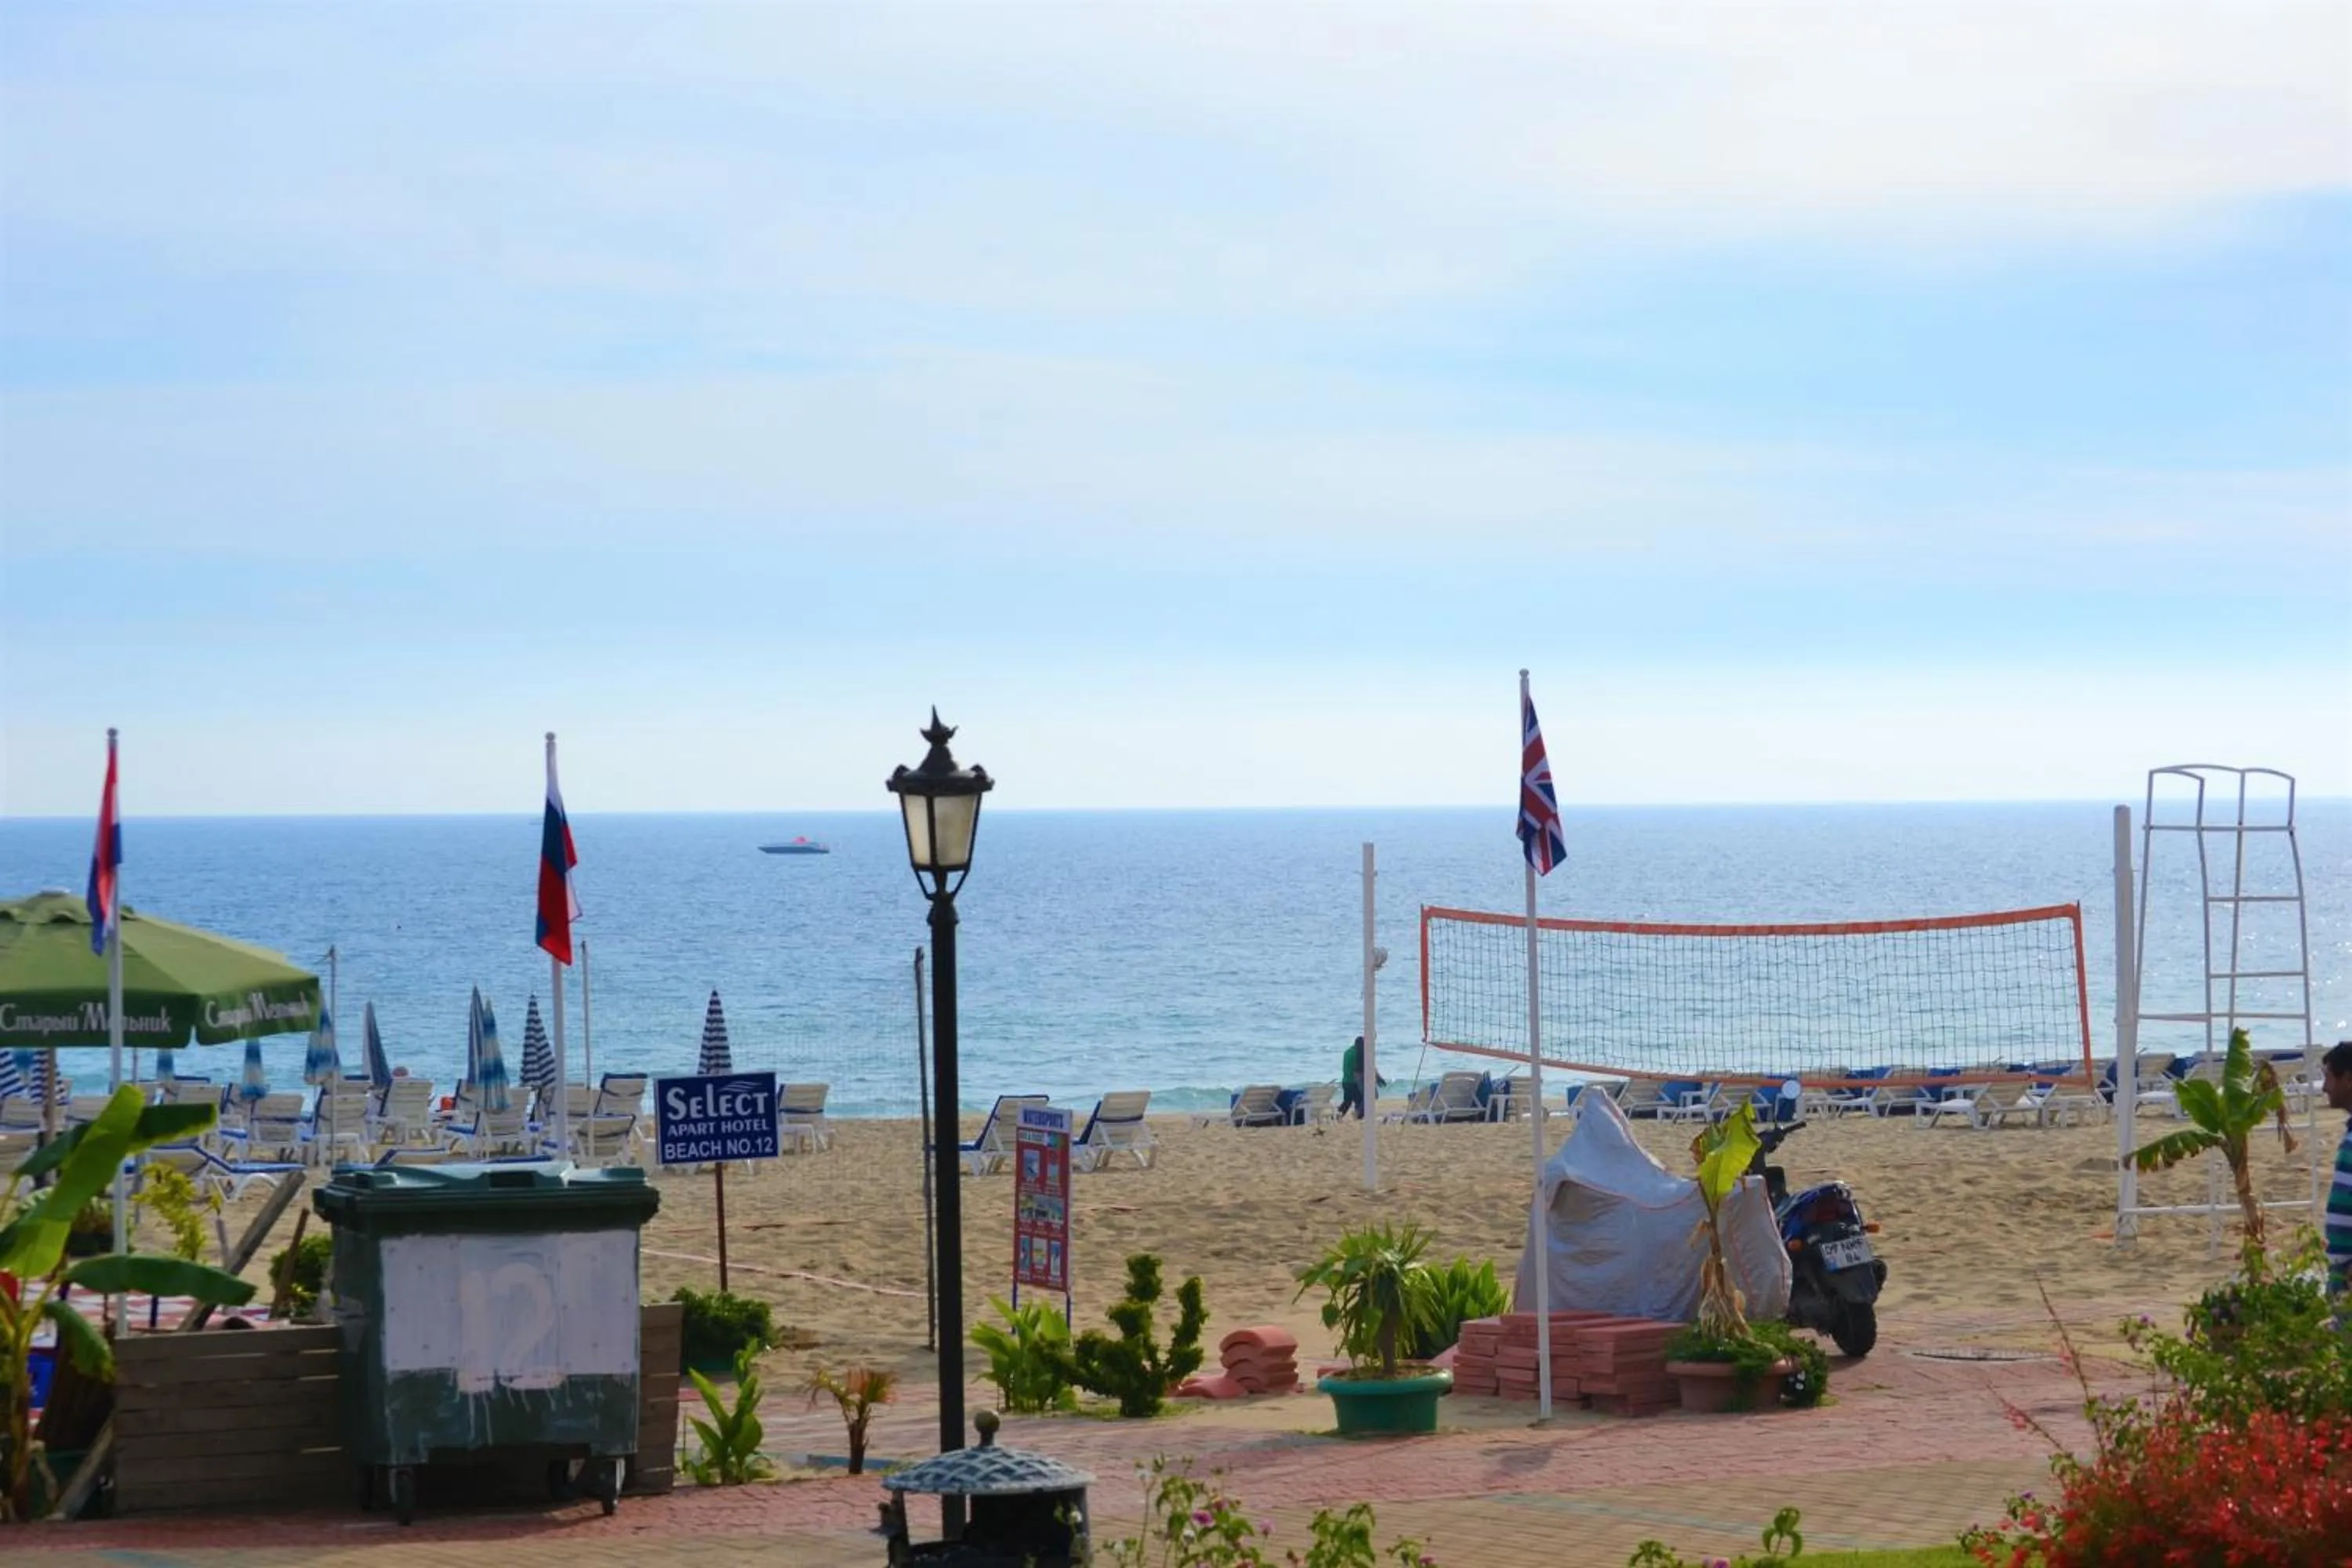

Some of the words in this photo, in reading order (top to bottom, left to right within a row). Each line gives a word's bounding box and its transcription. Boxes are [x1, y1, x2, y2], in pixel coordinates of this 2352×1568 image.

[0, 1003, 78, 1037] Старый
[79, 1001, 172, 1033] Мьник
[667, 1122, 716, 1137] APART
[720, 1119, 771, 1134] HOTEL
[665, 1139, 722, 1160] BEACH
[727, 1137, 774, 1155] NO.12
